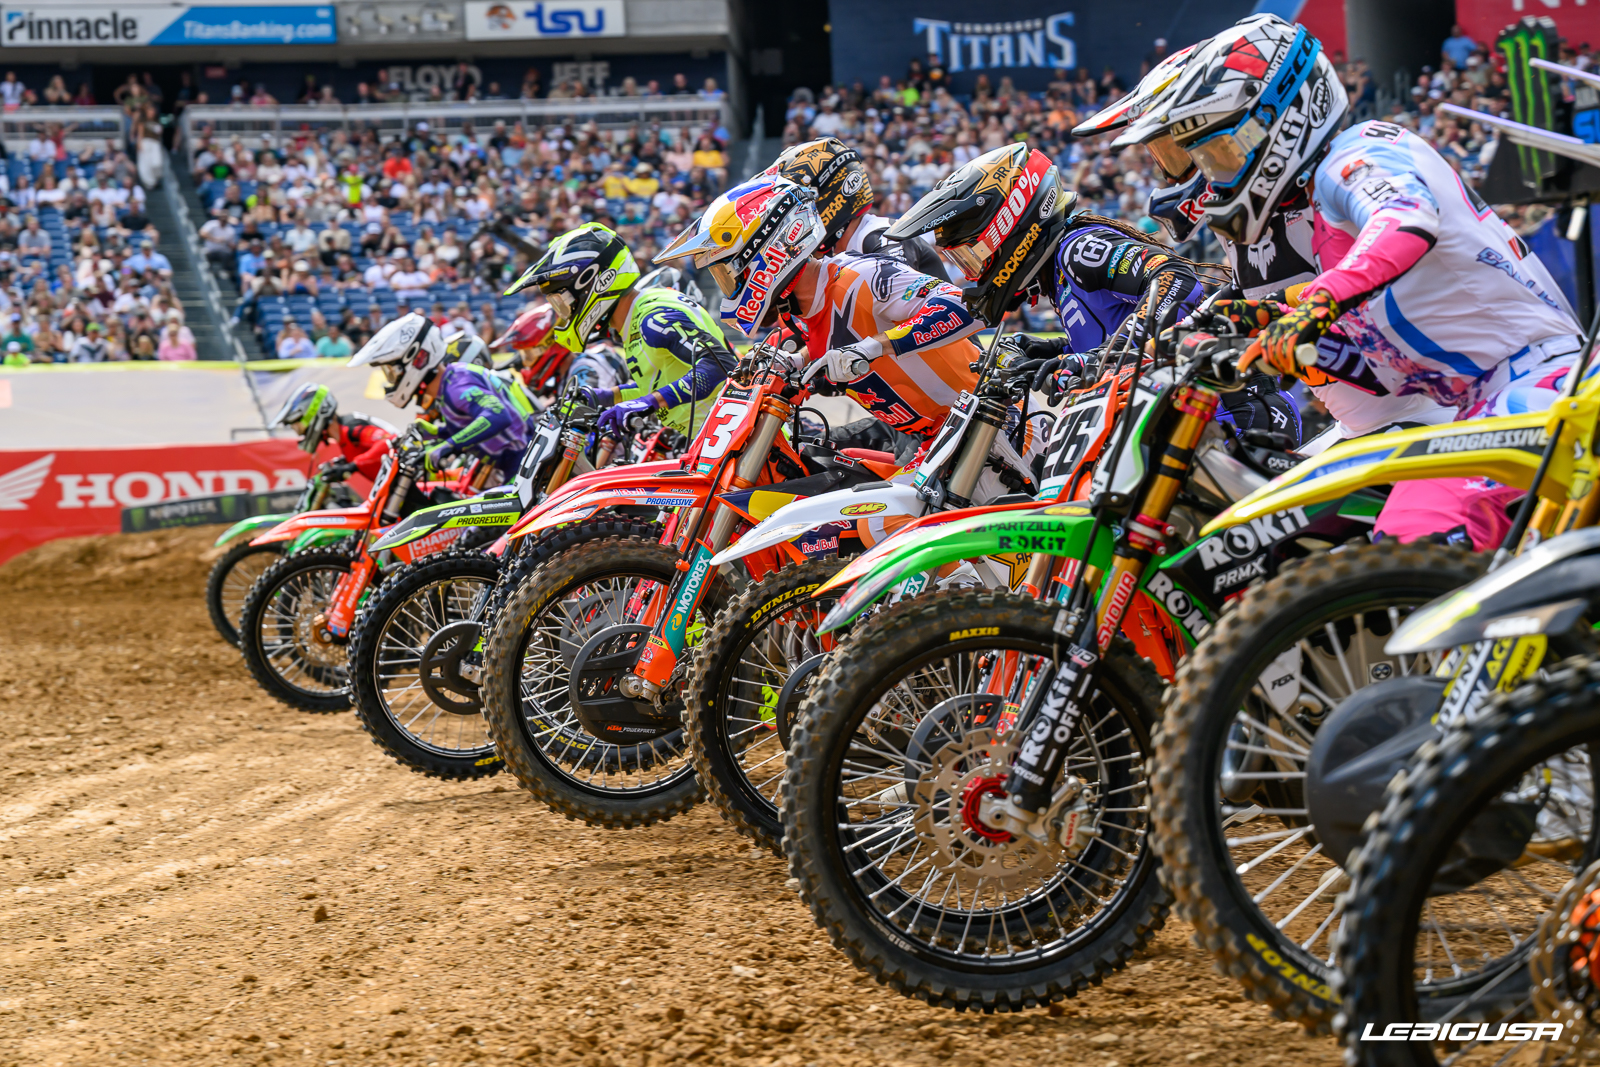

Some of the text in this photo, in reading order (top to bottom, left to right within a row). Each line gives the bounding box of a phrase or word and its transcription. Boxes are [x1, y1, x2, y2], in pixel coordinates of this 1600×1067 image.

[6, 11, 138, 41] Pinnacle
[183, 20, 332, 42] TitansBanking.com
[525, 3, 605, 34] tsu
[913, 12, 1077, 73] TITANS
[552, 61, 610, 87] JEFF
[842, 173, 863, 195] Arai
[985, 167, 1040, 250] 100%
[1042, 188, 1057, 215] SHOEI
[743, 197, 792, 260] OAKLEY
[787, 221, 803, 243] BELL
[993, 223, 1042, 287] ROCKSTAR
[599, 270, 615, 288] Arai
[914, 312, 964, 346] Red Bull
[700, 402, 749, 459] 3
[1426, 428, 1549, 454] PROGRESSIVE
[56, 469, 307, 509] HONDA
[619, 487, 646, 496] Bull
[645, 498, 694, 506] PROGRESSIVE
[437, 506, 467, 518] FXR
[456, 515, 511, 525] PROGRESSIVE
[842, 503, 886, 515] FMF
[989, 521, 1066, 532] PARTZILLA
[802, 537, 838, 553] Red Bull
[676, 554, 711, 614] MOTOREX
[1213, 553, 1268, 594] PRMX
[751, 583, 820, 624] DUNLOP
[770, 602, 794, 618] EXCEL
[1099, 571, 1137, 650] SHOWA
[950, 627, 1000, 641] MAXXIS
[622, 726, 656, 734] POWERPARTS
[1053, 700, 1081, 744] OFF
